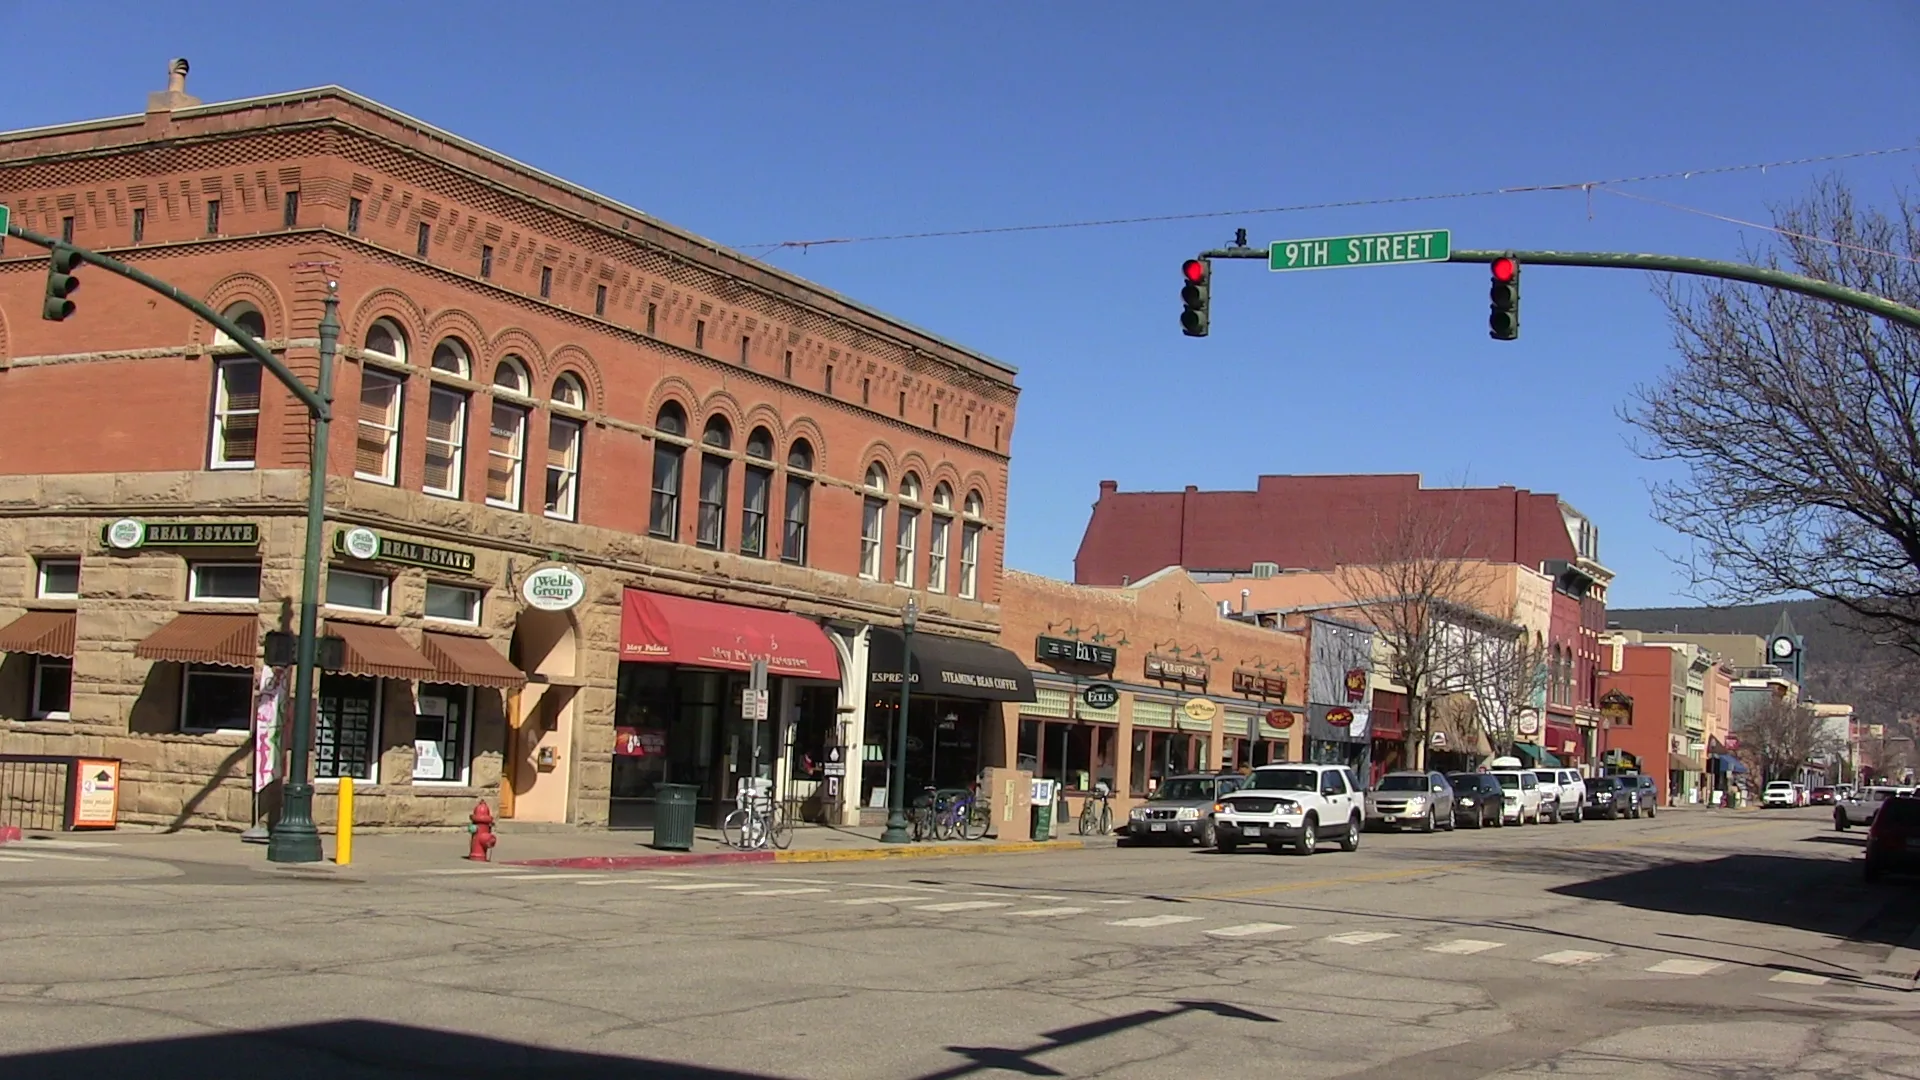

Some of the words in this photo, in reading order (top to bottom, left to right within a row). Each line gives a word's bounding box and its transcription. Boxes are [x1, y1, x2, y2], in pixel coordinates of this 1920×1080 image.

[1285, 241, 1328, 267] 9TH
[1346, 234, 1433, 263] STREET
[149, 526, 188, 541] REAL
[193, 526, 253, 541] ESTATE
[381, 540, 419, 559] REAL
[421, 546, 472, 569] ESTATE
[534, 575, 573, 587] Wells
[533, 586, 573, 599] Group
[871, 672, 919, 684] ESPRESO
[941, 671, 977, 687] STEAMING
[976, 674, 995, 688] BEAN
[994, 678, 1018, 691] COFFEE
